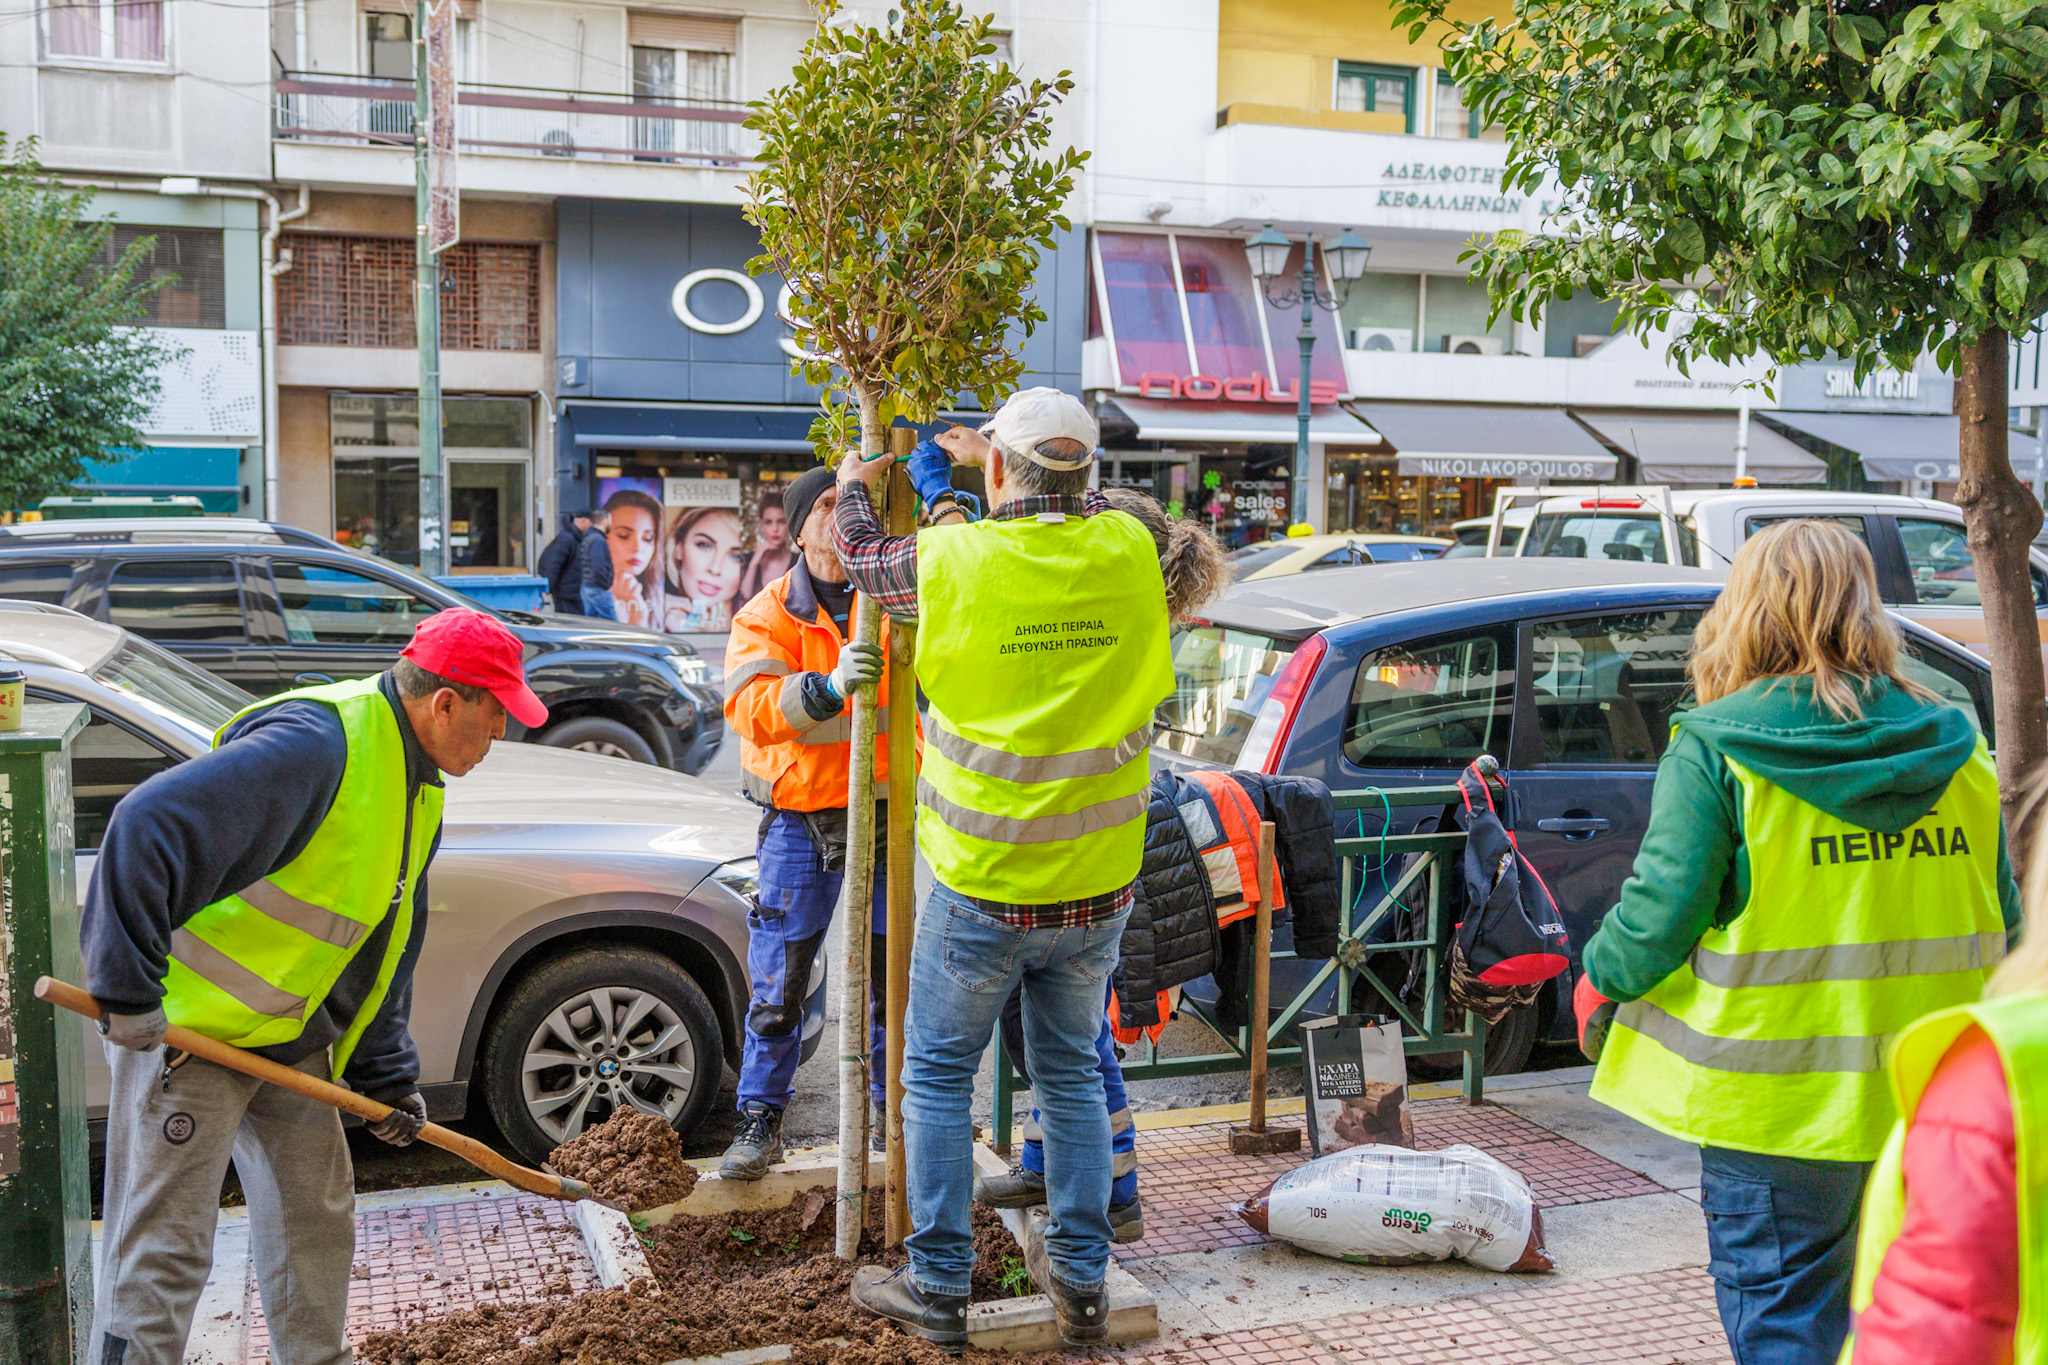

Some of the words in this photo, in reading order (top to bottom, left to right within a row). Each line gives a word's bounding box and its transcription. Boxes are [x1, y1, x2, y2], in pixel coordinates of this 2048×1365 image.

[1382, 162, 1518, 185] ΑΔΕΛΦΟΤΗΤ
[1377, 190, 1522, 214] ΚΕΦΑΛΛΗΝΩΝ
[1139, 371, 1339, 404] nodus
[1422, 459, 1595, 478] NIKOLAKOPOULOS
[1234, 493, 1287, 510] sales
[1015, 623, 1059, 636] ΔΗΜΟΣ
[1061, 620, 1105, 632] ΠΕΙΡΑΙΑ
[1000, 640, 1063, 655] ΔΙΕΥΘΥΝΣΗ
[1066, 635, 1119, 649] ΠΡΑΣΙΝΟΥ
[1810, 826, 1971, 866] ΠΕΙΡΑΙΑ
[1305, 1206, 1328, 1219] 50L
[1384, 1208, 1432, 1228] Grow
[1382, 1216, 1422, 1234] Terra
